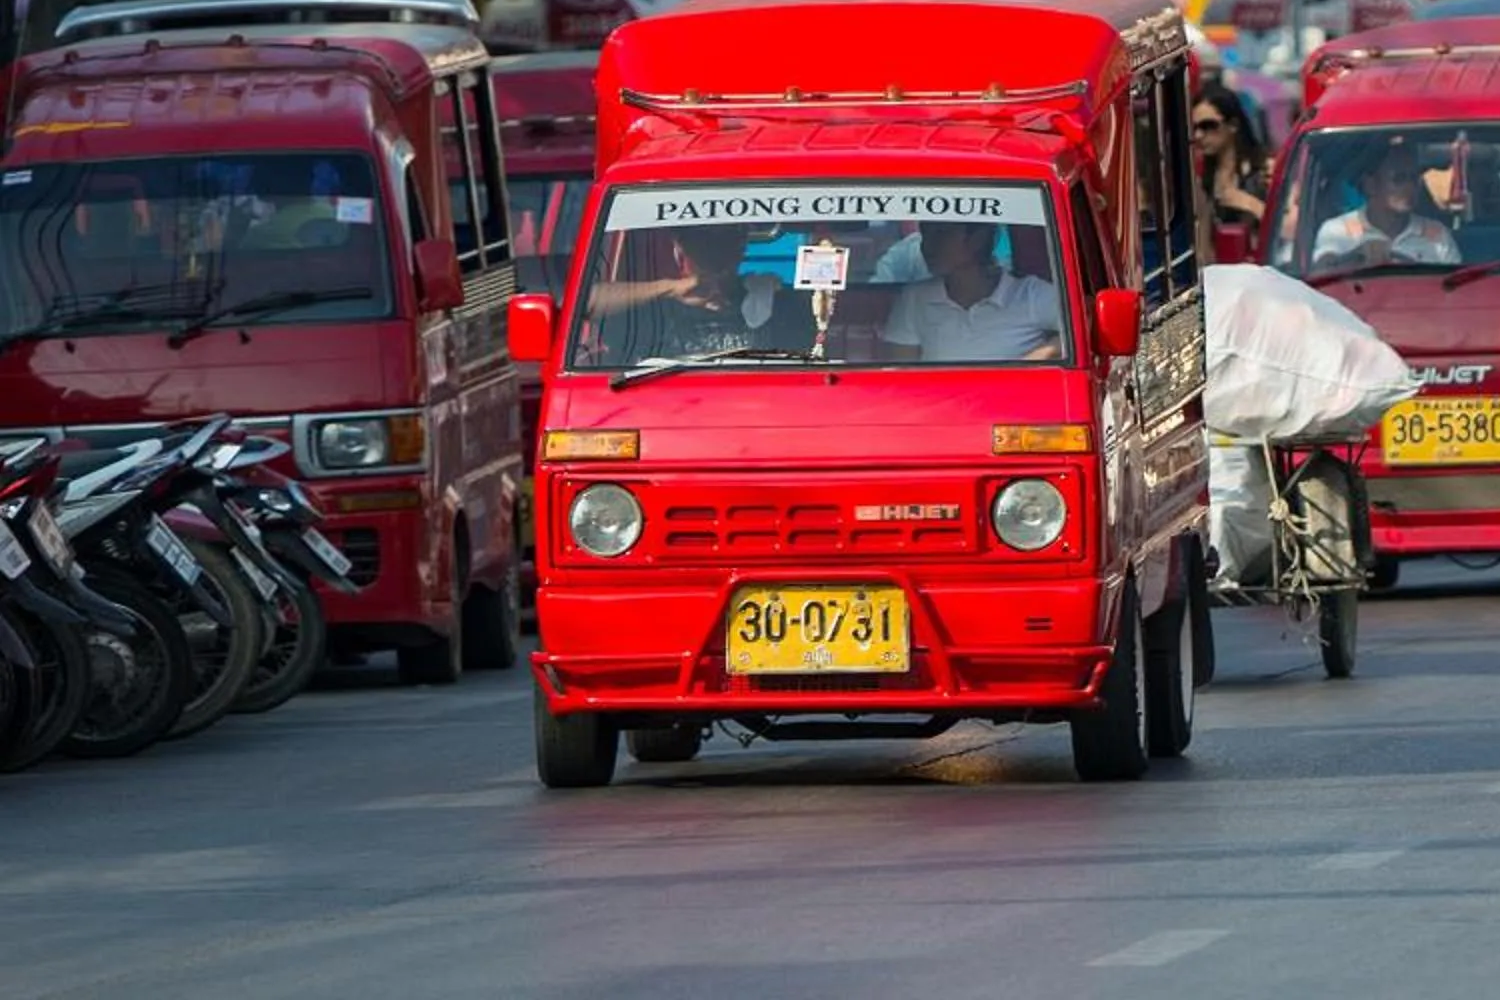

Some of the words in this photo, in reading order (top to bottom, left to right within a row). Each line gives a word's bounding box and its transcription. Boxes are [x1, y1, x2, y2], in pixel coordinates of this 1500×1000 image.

[656, 197, 800, 221] PATONG
[811, 195, 892, 217] CITY
[902, 195, 1003, 217] TOUR
[883, 504, 960, 521] HIJET
[738, 599, 892, 643] 30-0731
